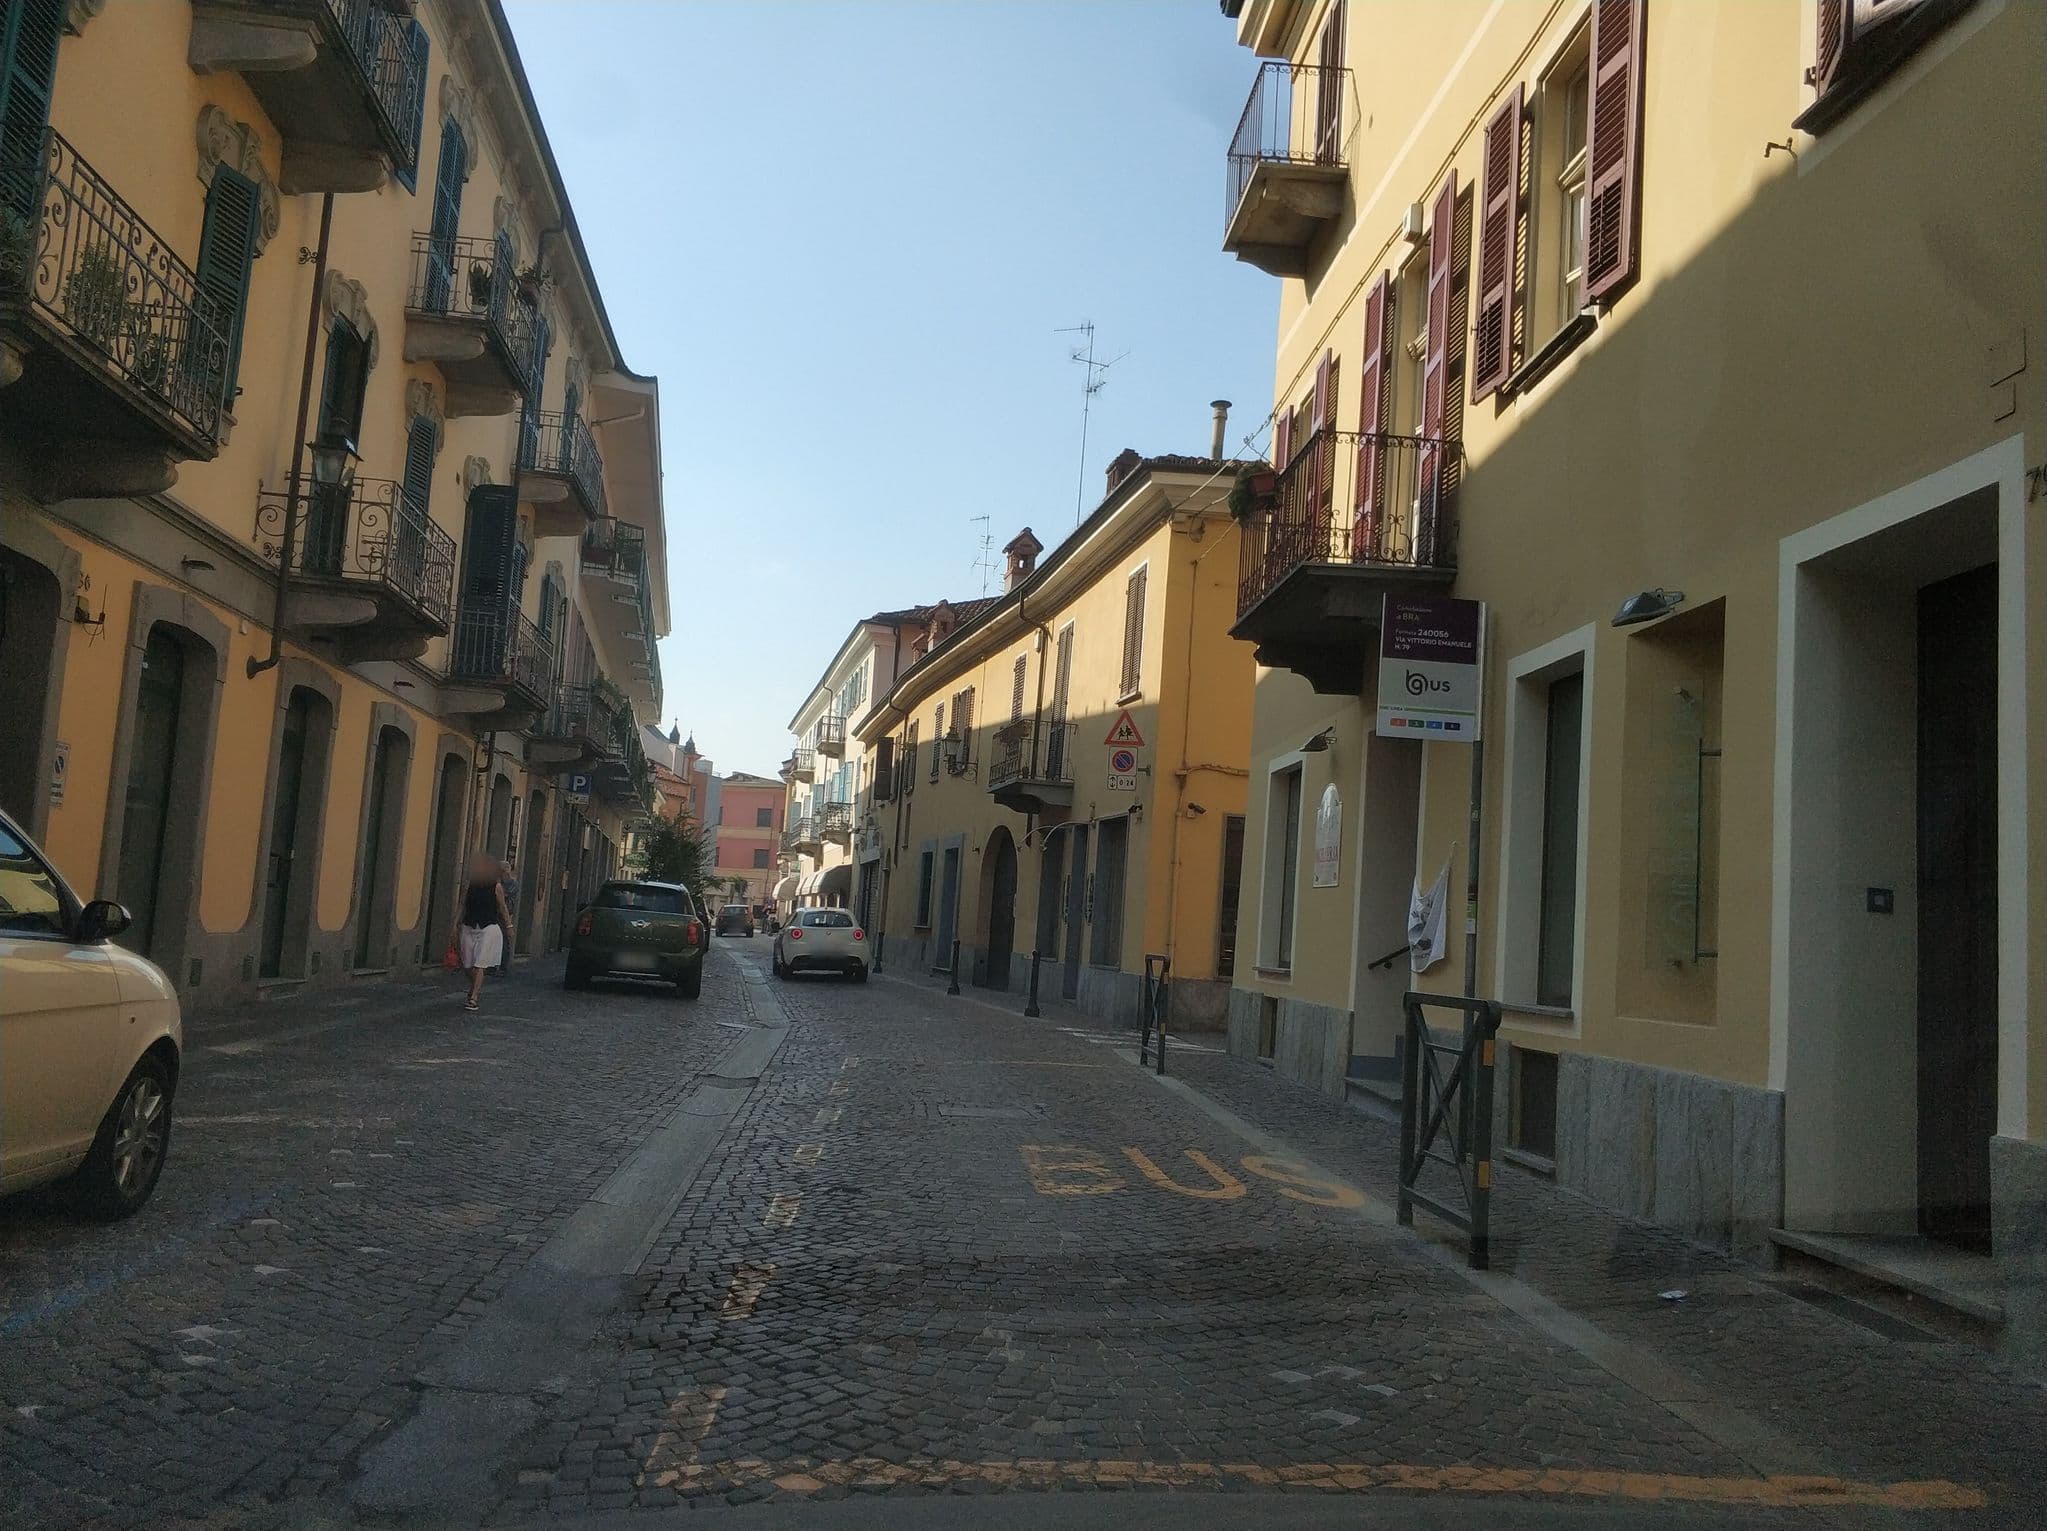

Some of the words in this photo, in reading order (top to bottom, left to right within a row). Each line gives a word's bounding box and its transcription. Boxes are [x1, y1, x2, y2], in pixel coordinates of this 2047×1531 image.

[1418, 629, 1449, 638] 240056
[1407, 637, 1437, 646] VITTORIO
[573, 775, 587, 792] P
[1018, 1144, 1365, 1209] BUS
